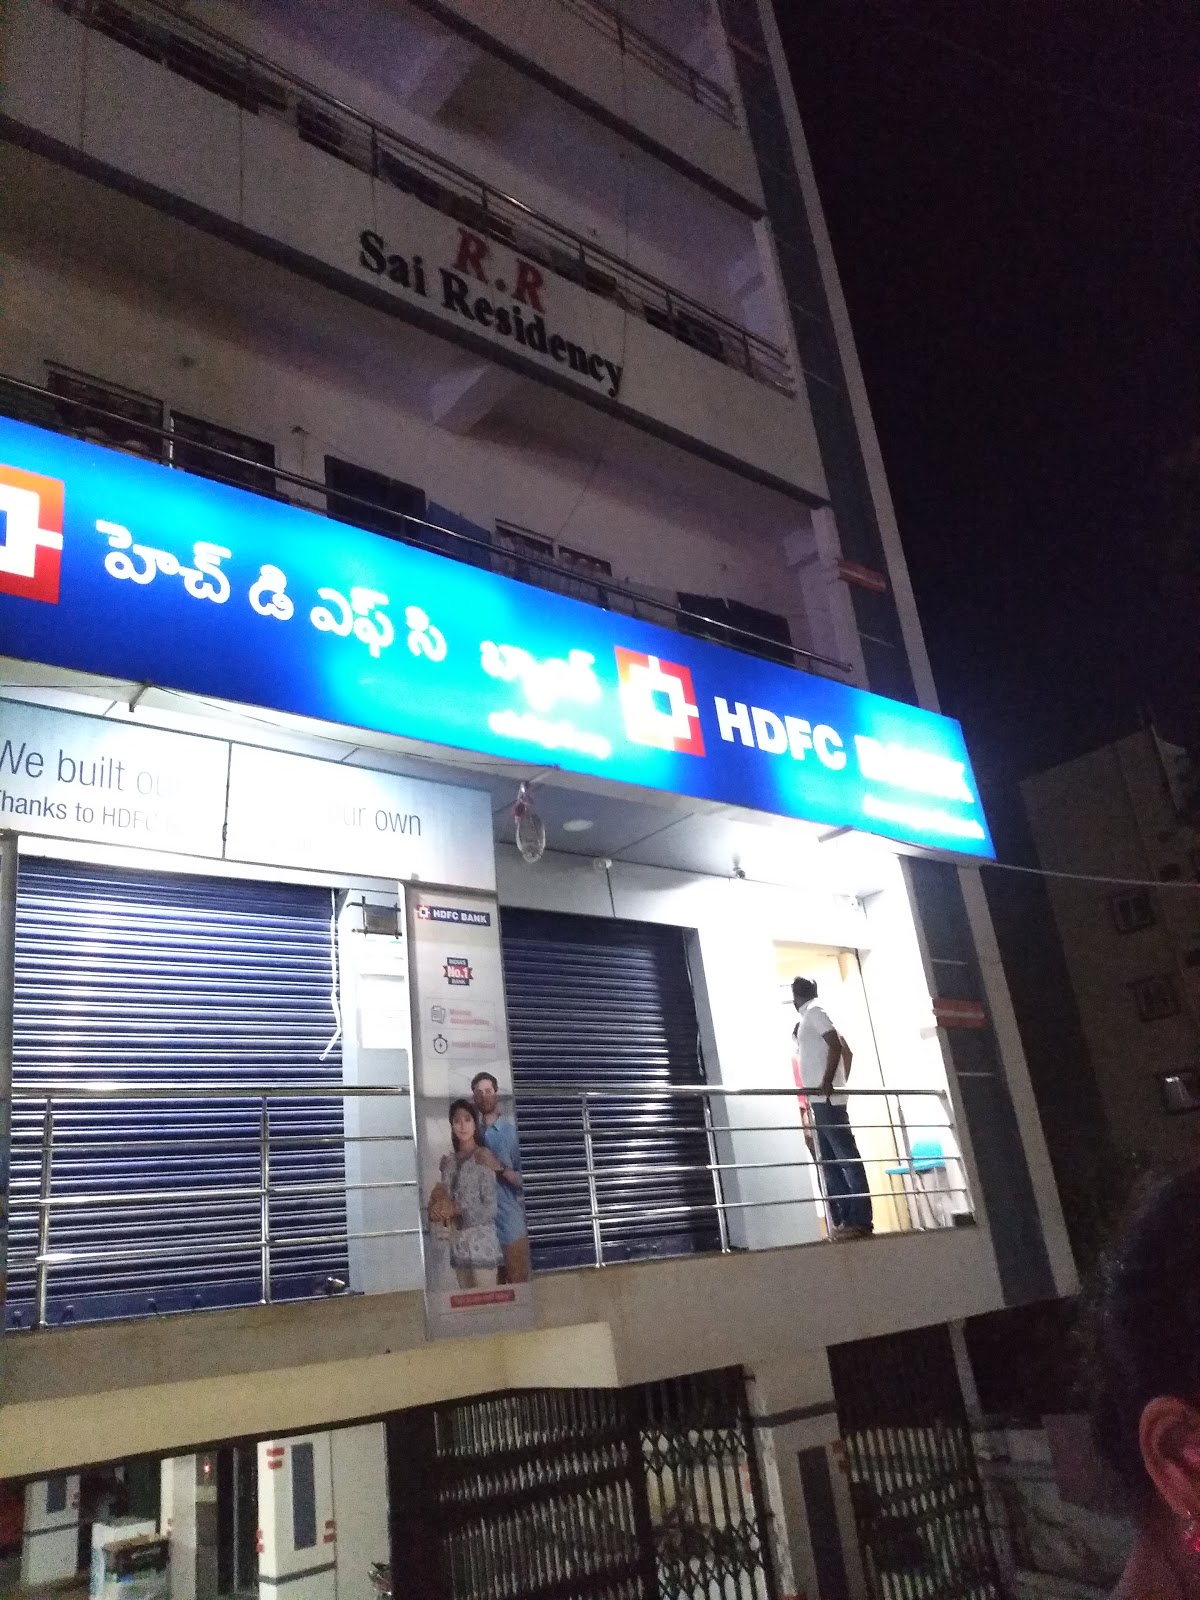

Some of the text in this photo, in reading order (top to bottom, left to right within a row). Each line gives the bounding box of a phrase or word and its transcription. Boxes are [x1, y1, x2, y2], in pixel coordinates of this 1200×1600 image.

[455, 227, 546, 313] R.R
[358, 229, 623, 398] Sai Residency
[714, 696, 846, 771] HDFC
[0, 789, 68, 820] hanks
[75, 801, 95, 825] to
[57, 748, 126, 793] built
[374, 809, 422, 837] own
[433, 909, 487, 924] HDFC BANK
[447, 966, 468, 979] No.1
